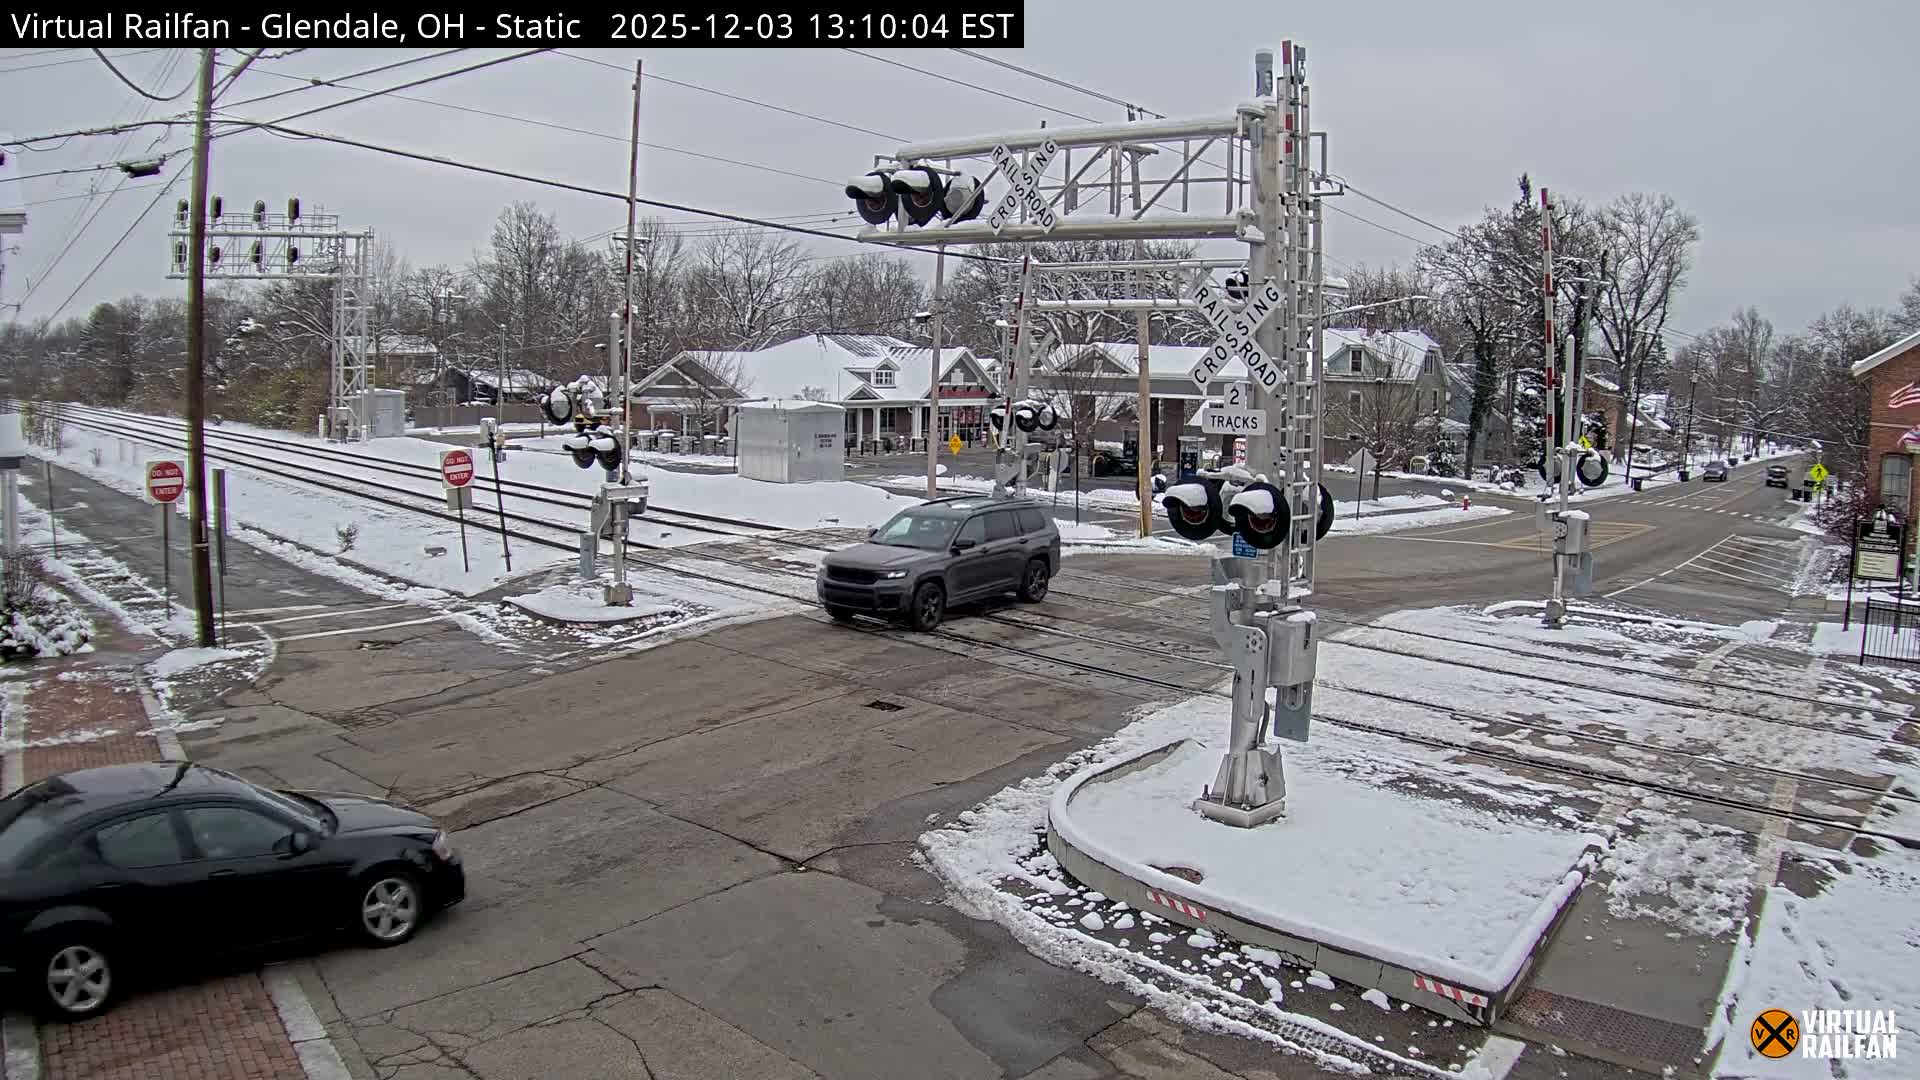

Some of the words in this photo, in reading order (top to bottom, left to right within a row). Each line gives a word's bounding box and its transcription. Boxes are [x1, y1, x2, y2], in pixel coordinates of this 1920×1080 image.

[990, 140, 1056, 229] CROSSING
[992, 145, 1053, 228] RAILROAD
[1194, 286, 1279, 384] CROSSING
[1194, 286, 1277, 387] RAILROAD
[1210, 415, 1258, 430] TRACKS
[1229, 388, 1240, 405] 2
